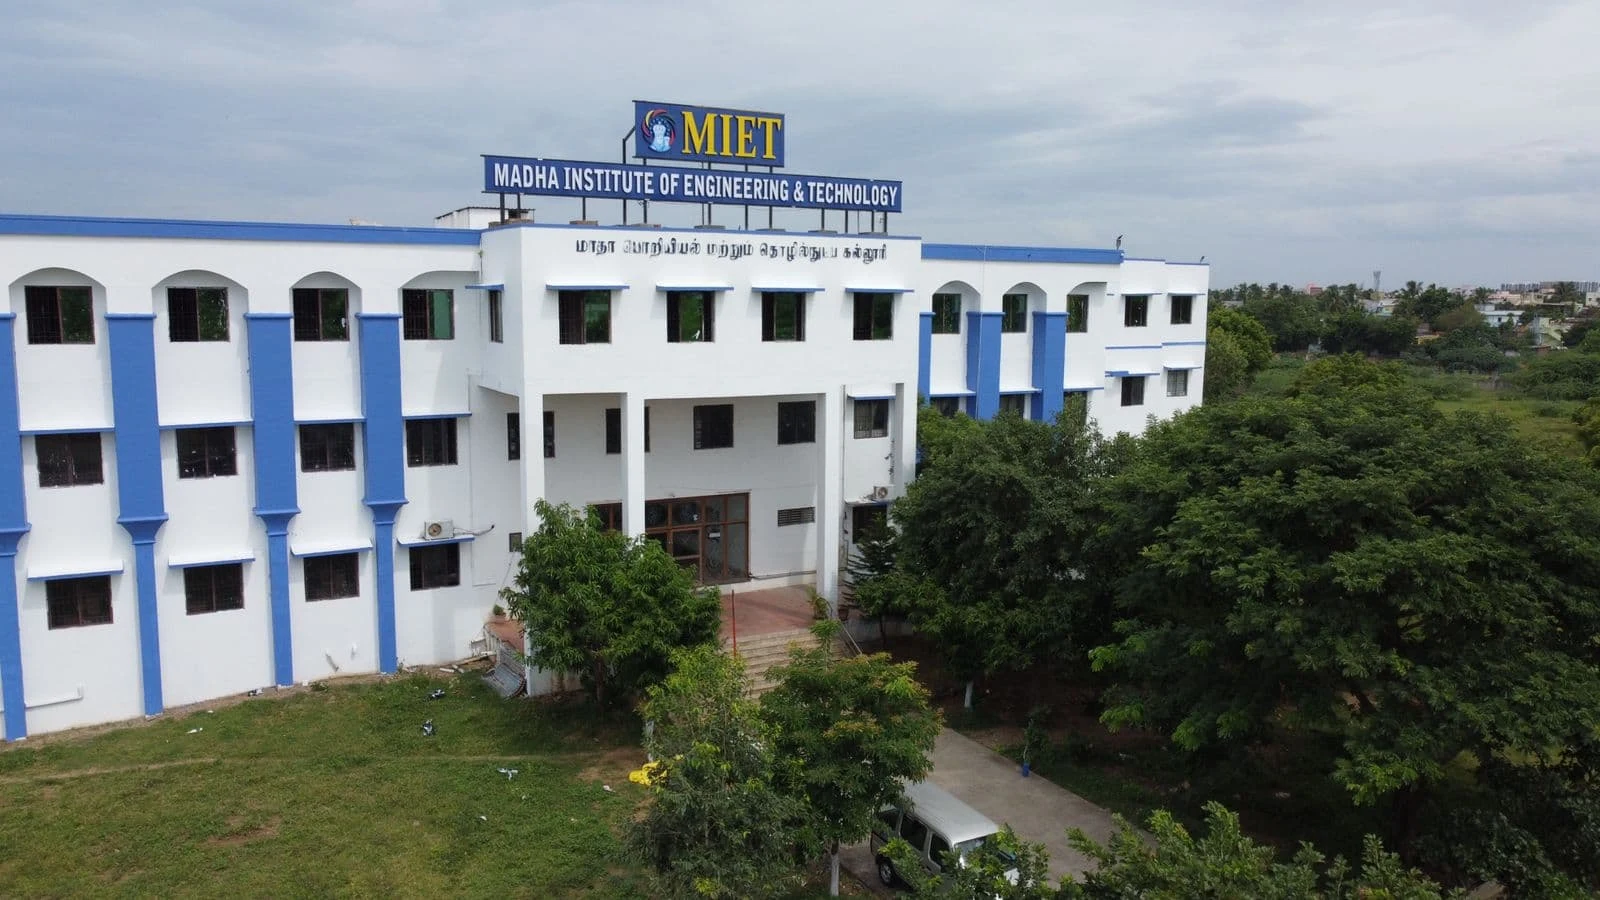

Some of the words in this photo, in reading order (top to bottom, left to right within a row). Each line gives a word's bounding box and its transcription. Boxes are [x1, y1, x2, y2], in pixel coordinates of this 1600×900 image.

[681, 110, 782, 160] MIET
[494, 163, 560, 190] MADHA
[563, 167, 654, 194] INSTITUTE
[659, 173, 680, 196] OF
[684, 174, 789, 201] ENGINEERING
[793, 181, 804, 203] &
[807, 181, 898, 206] TECHNOLOGY
[576, 239, 616, 255] மாதா
